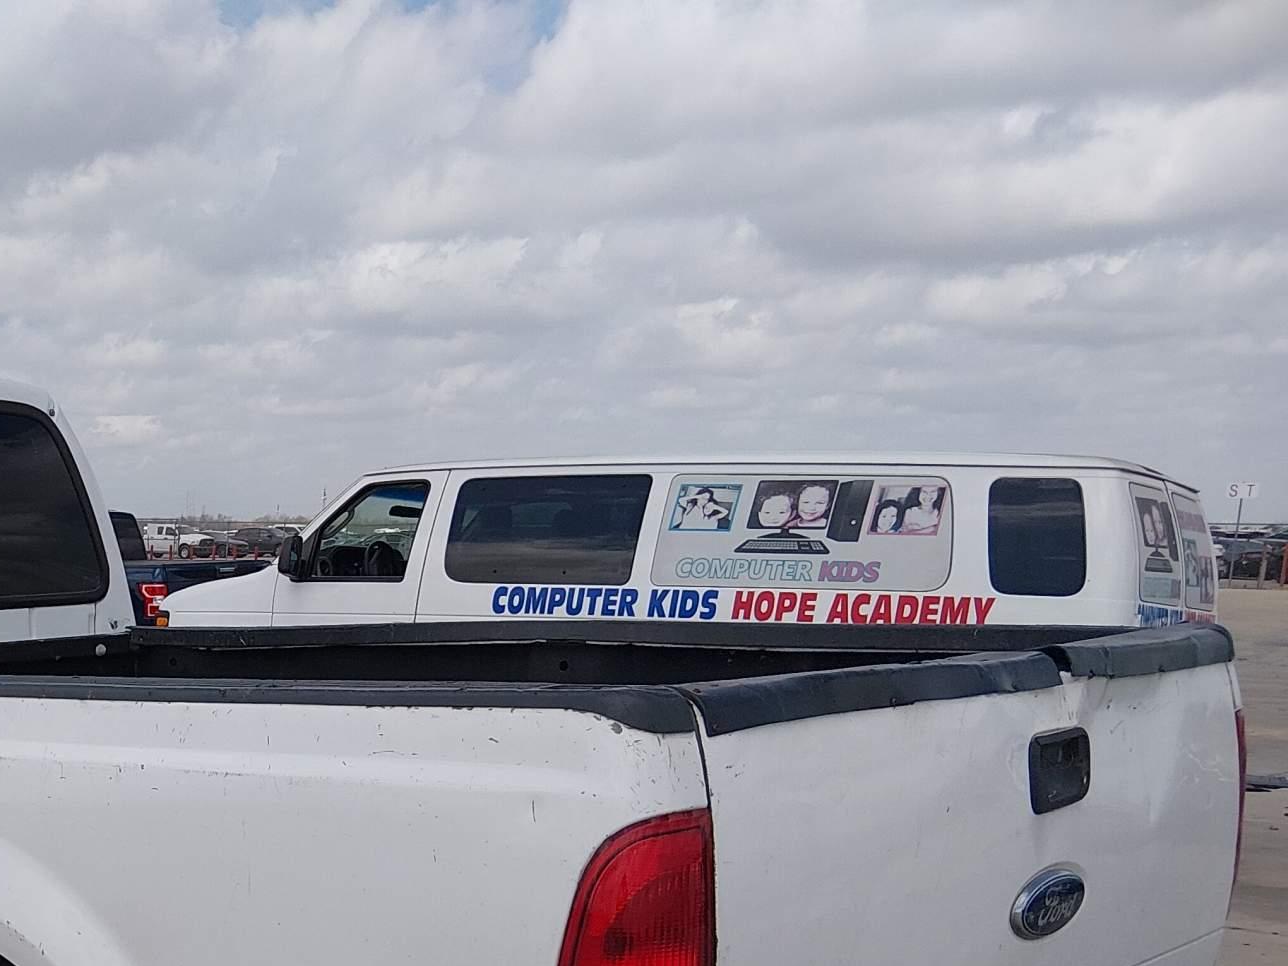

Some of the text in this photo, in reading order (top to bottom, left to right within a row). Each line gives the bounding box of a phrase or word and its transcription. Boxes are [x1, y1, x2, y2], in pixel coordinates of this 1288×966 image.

[675, 556, 882, 583] COMPUTER KIDS
[492, 585, 997, 625] COMPUTER KIDS HOPE ACADEMY
